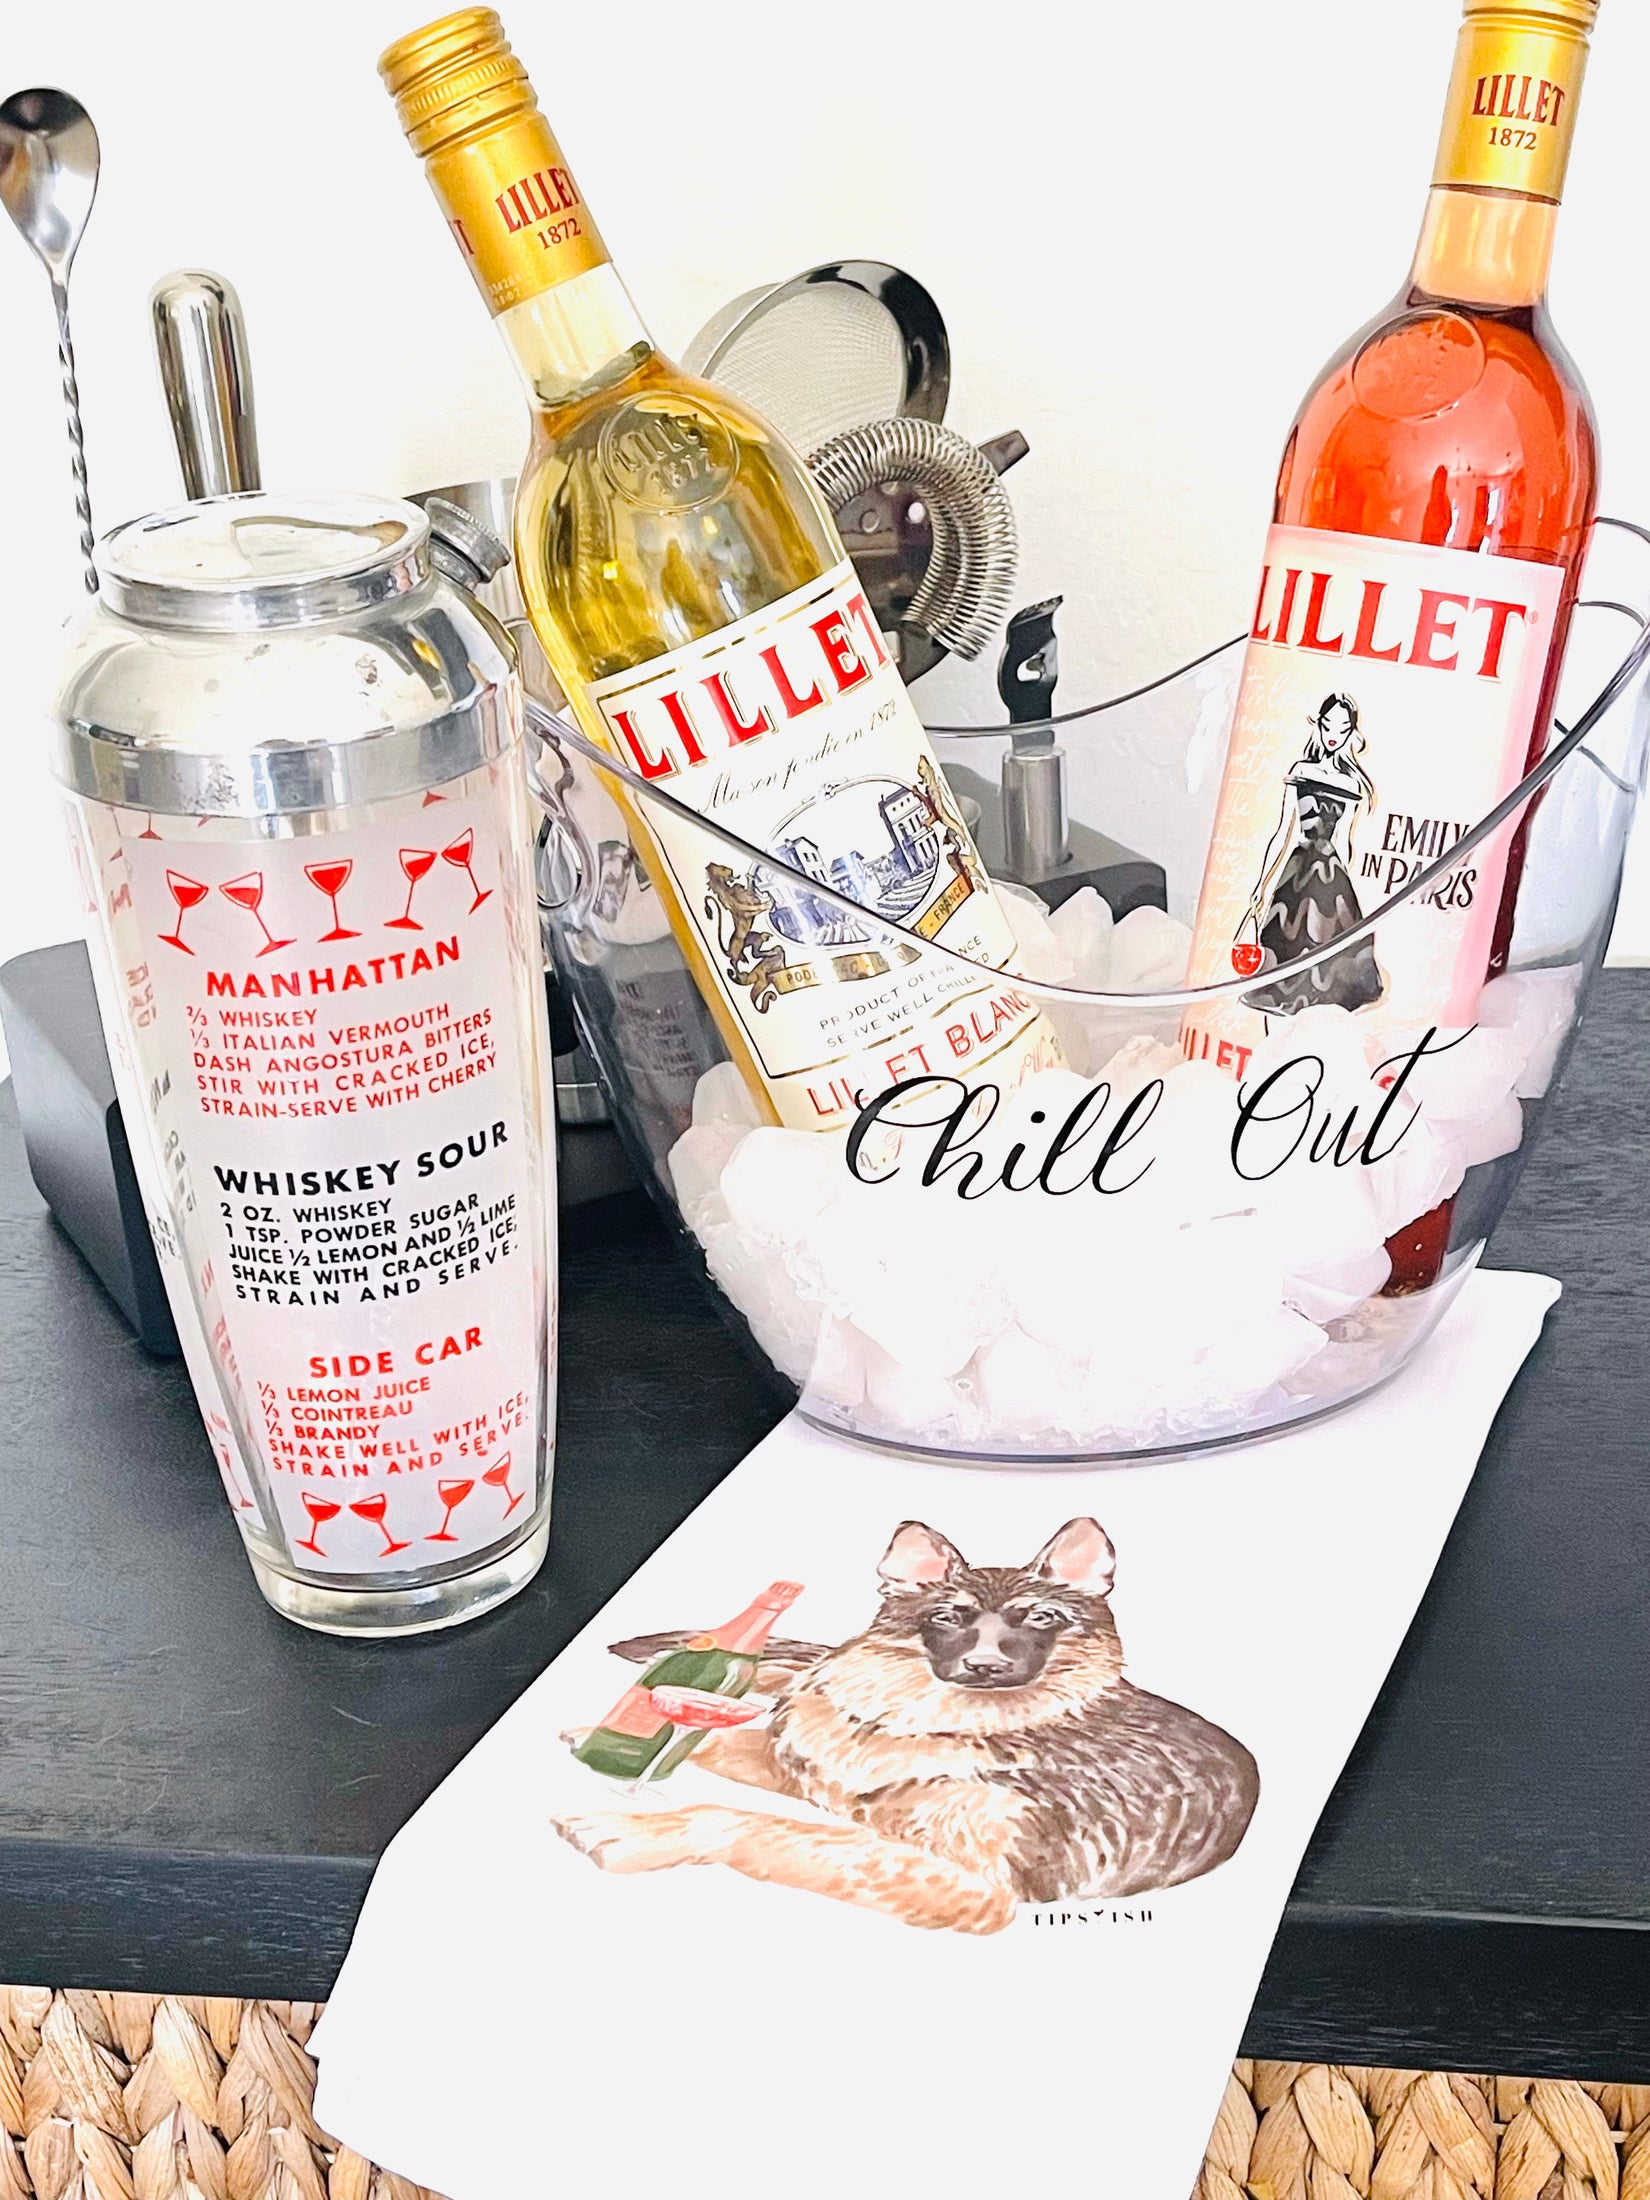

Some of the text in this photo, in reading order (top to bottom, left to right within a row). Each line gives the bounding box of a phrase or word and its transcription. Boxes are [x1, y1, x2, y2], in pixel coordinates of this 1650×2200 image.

[1472, 74, 1565, 126] LILLET
[1488, 127, 1537, 151] 1872
[495, 168, 579, 233] LILLET
[537, 217, 582, 250] 1872
[1251, 565, 1528, 681] LILLET
[611, 593, 890, 781] LILLET
[1361, 853, 1477, 911] IN PARIS
[206, 935, 460, 998] MANHATTAN
[218, 1008, 318, 1030] WHISKEY
[223, 1028, 317, 1052] ITALIAN
[328, 1003, 450, 1046] VERMOUTH
[887, 993, 934, 1022] WELL
[193, 1008, 492, 1074] DASH ANGOSTURA BITTERS
[197, 1034, 495, 1098] STIR WITH CRACKED ICE,
[201, 1052, 498, 1119] STRAIN-SERVE WITH CHERRY
[806, 1044, 932, 1116] LILET
[845, 1075, 1164, 1200] Chill
[1230, 1023, 1478, 1181] Out
[214, 1120, 509, 1196] WHISKEY SOUR
[220, 1198, 393, 1224] 2 OZ. WHISKEY
[225, 1193, 480, 1244] 1 TSP. POWDER SUGAR
[229, 1244, 284, 1264] JUICE
[318, 1241, 398, 1265] LEMON
[405, 1226, 452, 1253] AND
[480, 1193, 517, 1228] LIME
[232, 1264, 301, 1286] SHAKE
[314, 1266, 369, 1285] WITH
[382, 1236, 480, 1277] CRACKED
[236, 1240, 520, 1306] STRAIN AND SERVE.
[309, 1327, 484, 1379] SIDE CAR
[287, 1387, 361, 1403] LEMON
[373, 1377, 431, 1399] JUICE
[291, 1401, 414, 1422] COINTREAU
[269, 1439, 346, 1459] SHAKE
[359, 1439, 420, 1458] WELL
[433, 1415, 488, 1444] WITH
[273, 1415, 529, 1478] STRAIN AND SERVE.
[295, 1424, 380, 1440] BRANDY
